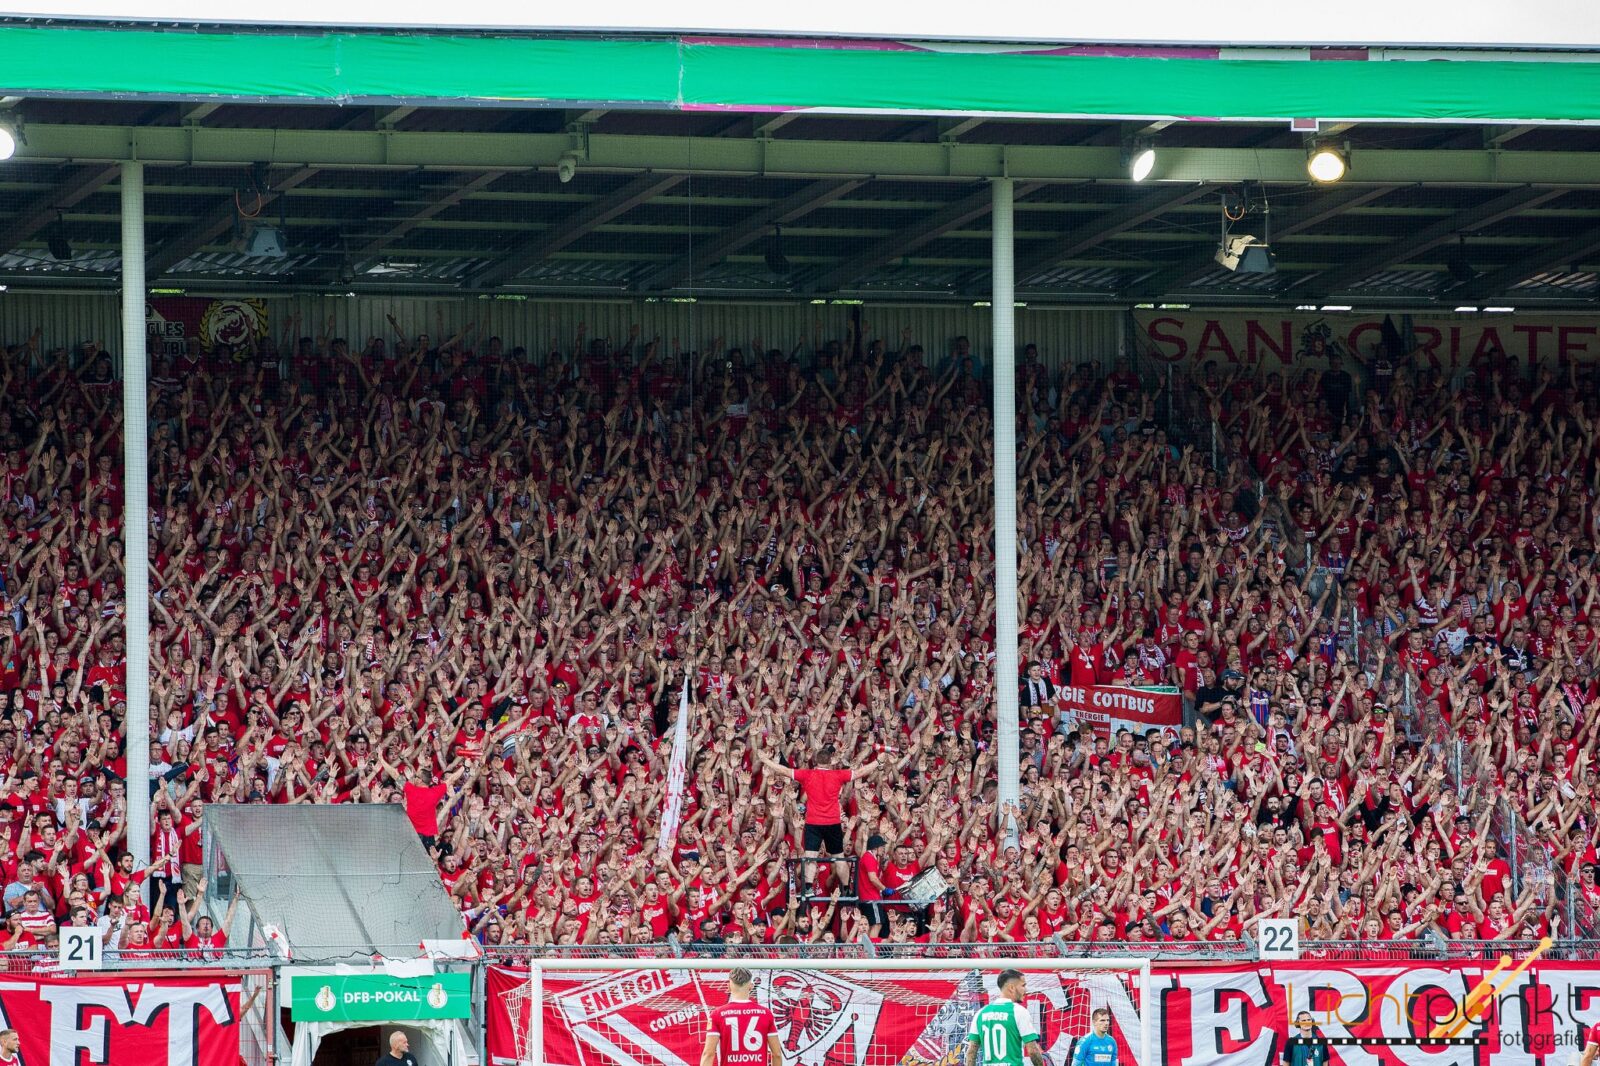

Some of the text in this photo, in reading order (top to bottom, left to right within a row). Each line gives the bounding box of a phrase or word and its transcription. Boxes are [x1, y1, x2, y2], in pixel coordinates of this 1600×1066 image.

[1147, 316, 1293, 364] SAN
[1092, 691, 1155, 714] COTTBUS
[1075, 711, 1105, 721] ENERGIE
[68, 934, 94, 960] 21
[1264, 926, 1294, 951] 22
[344, 990, 421, 1004] DFB-POKAL
[580, 969, 674, 1016] ENERGIE
[649, 1004, 699, 1032] COTTBUS
[720, 1009, 741, 1017] ENERGIE
[725, 1016, 763, 1052] 16
[982, 1023, 1007, 1061] 10
[727, 1053, 763, 1063] KUJOVIC
